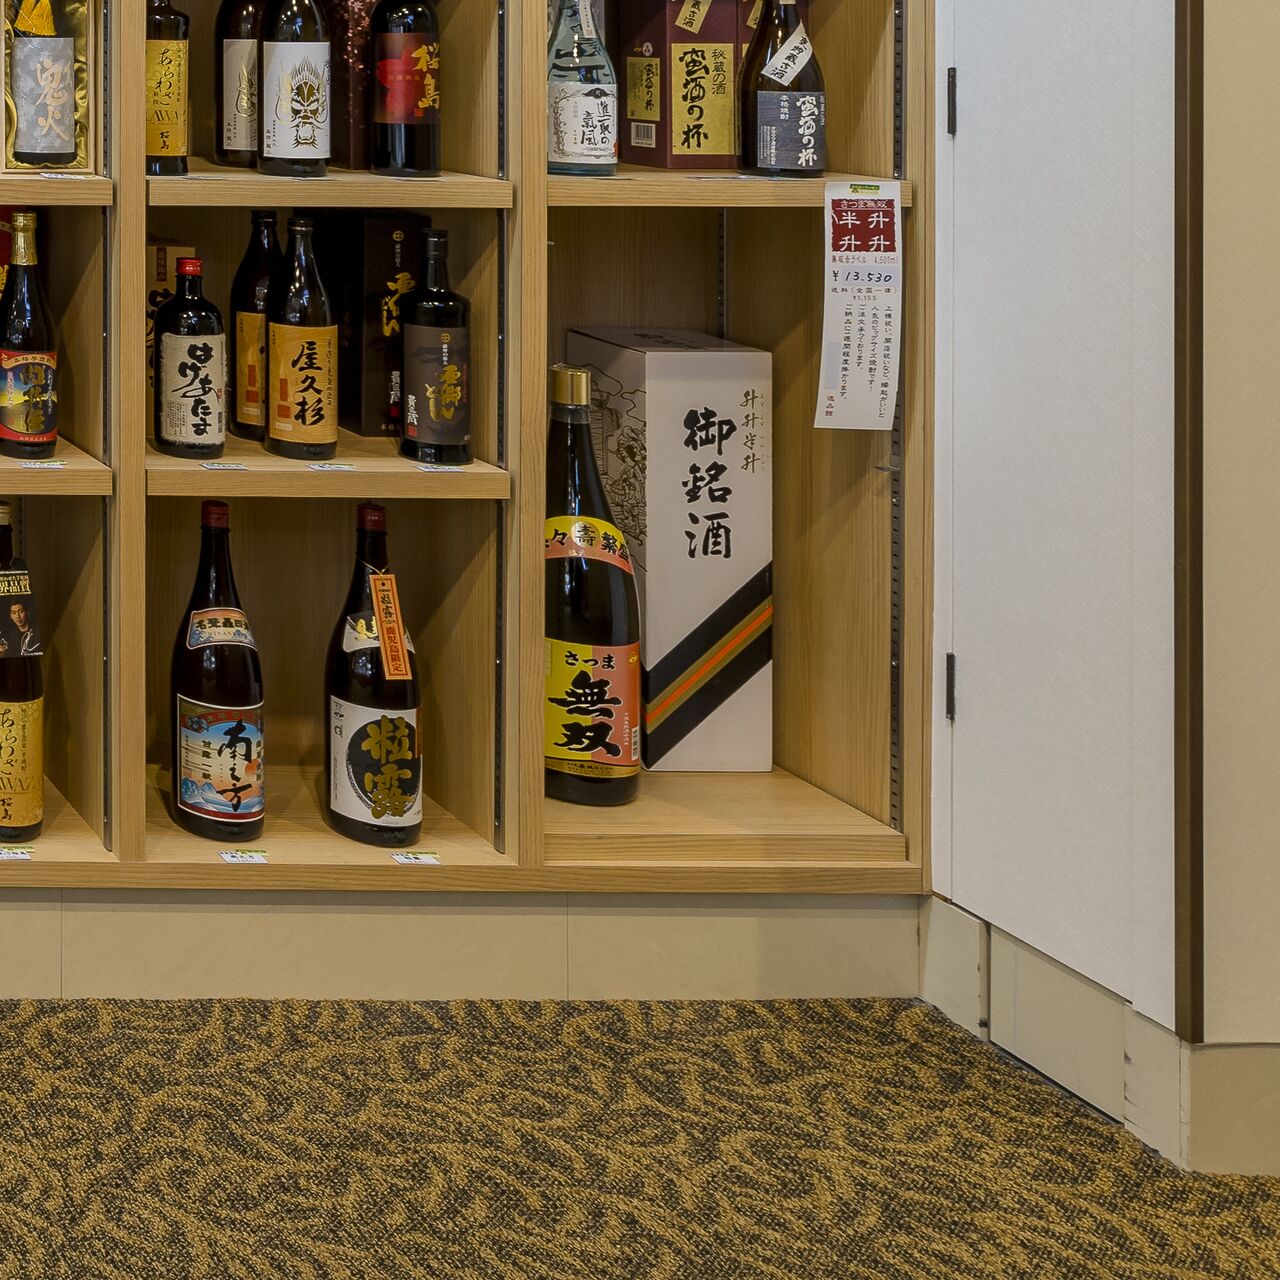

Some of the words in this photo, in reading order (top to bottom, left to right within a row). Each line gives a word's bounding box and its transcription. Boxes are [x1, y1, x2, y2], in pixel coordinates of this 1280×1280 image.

[411, 43, 440, 110] 桜島
[679, 47, 710, 149] 蛮酒の杯
[711, 49, 727, 96] 秘蔵の酒
[779, 94, 790, 120] 本格焼酎
[796, 94, 819, 167] 蛮酒の杯
[840, 200, 887, 209] さつま無双
[832, 270, 839, 281] ¥
[291, 341, 327, 426] 屋久杉
[740, 389, 761, 473] 升升半升
[681, 406, 738, 561] 御銘酒
[386, 628, 402, 673] 鹿児島限定
[564, 651, 616, 671] さつま
[547, 670, 624, 757] 無双
[217, 719, 255, 812] 南之方
